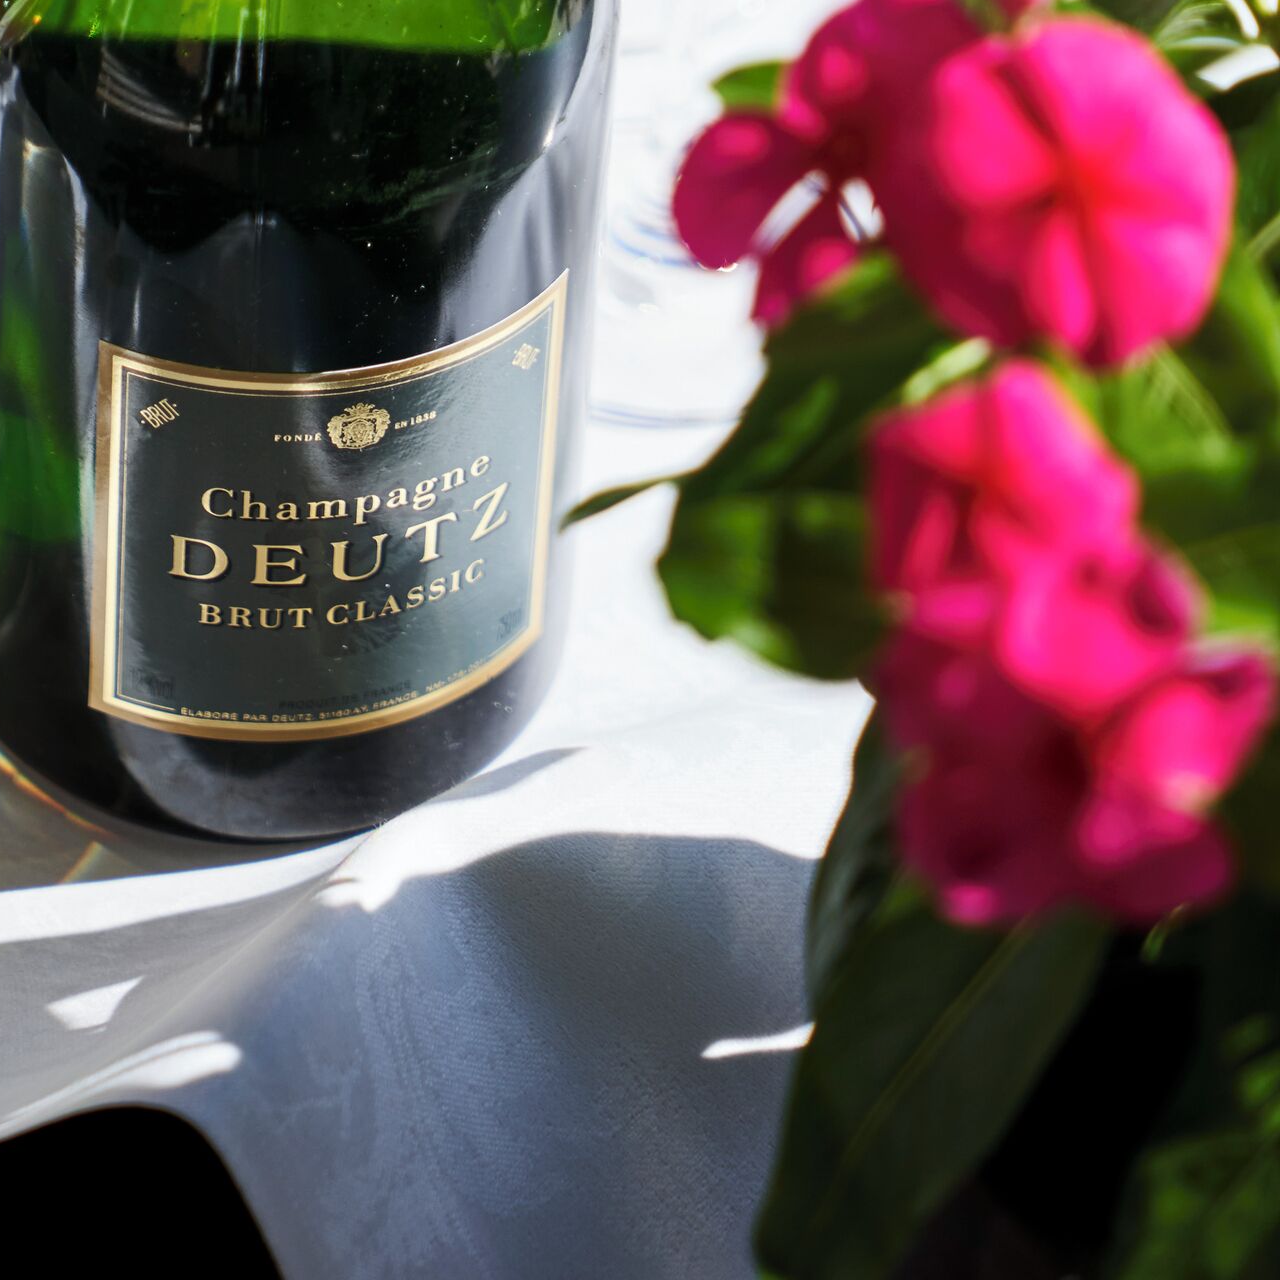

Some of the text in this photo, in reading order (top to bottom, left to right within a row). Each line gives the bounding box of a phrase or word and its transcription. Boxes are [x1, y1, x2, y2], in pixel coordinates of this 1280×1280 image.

[394, 421, 408, 430] EN
[200, 454, 491, 526] Champagne
[167, 481, 511, 587] DEUTZ
[198, 602, 313, 630] BRUT
[325, 558, 485, 626] CLASSIC
[242, 712, 268, 722] PAR
[372, 690, 418, 710] FRANCE
